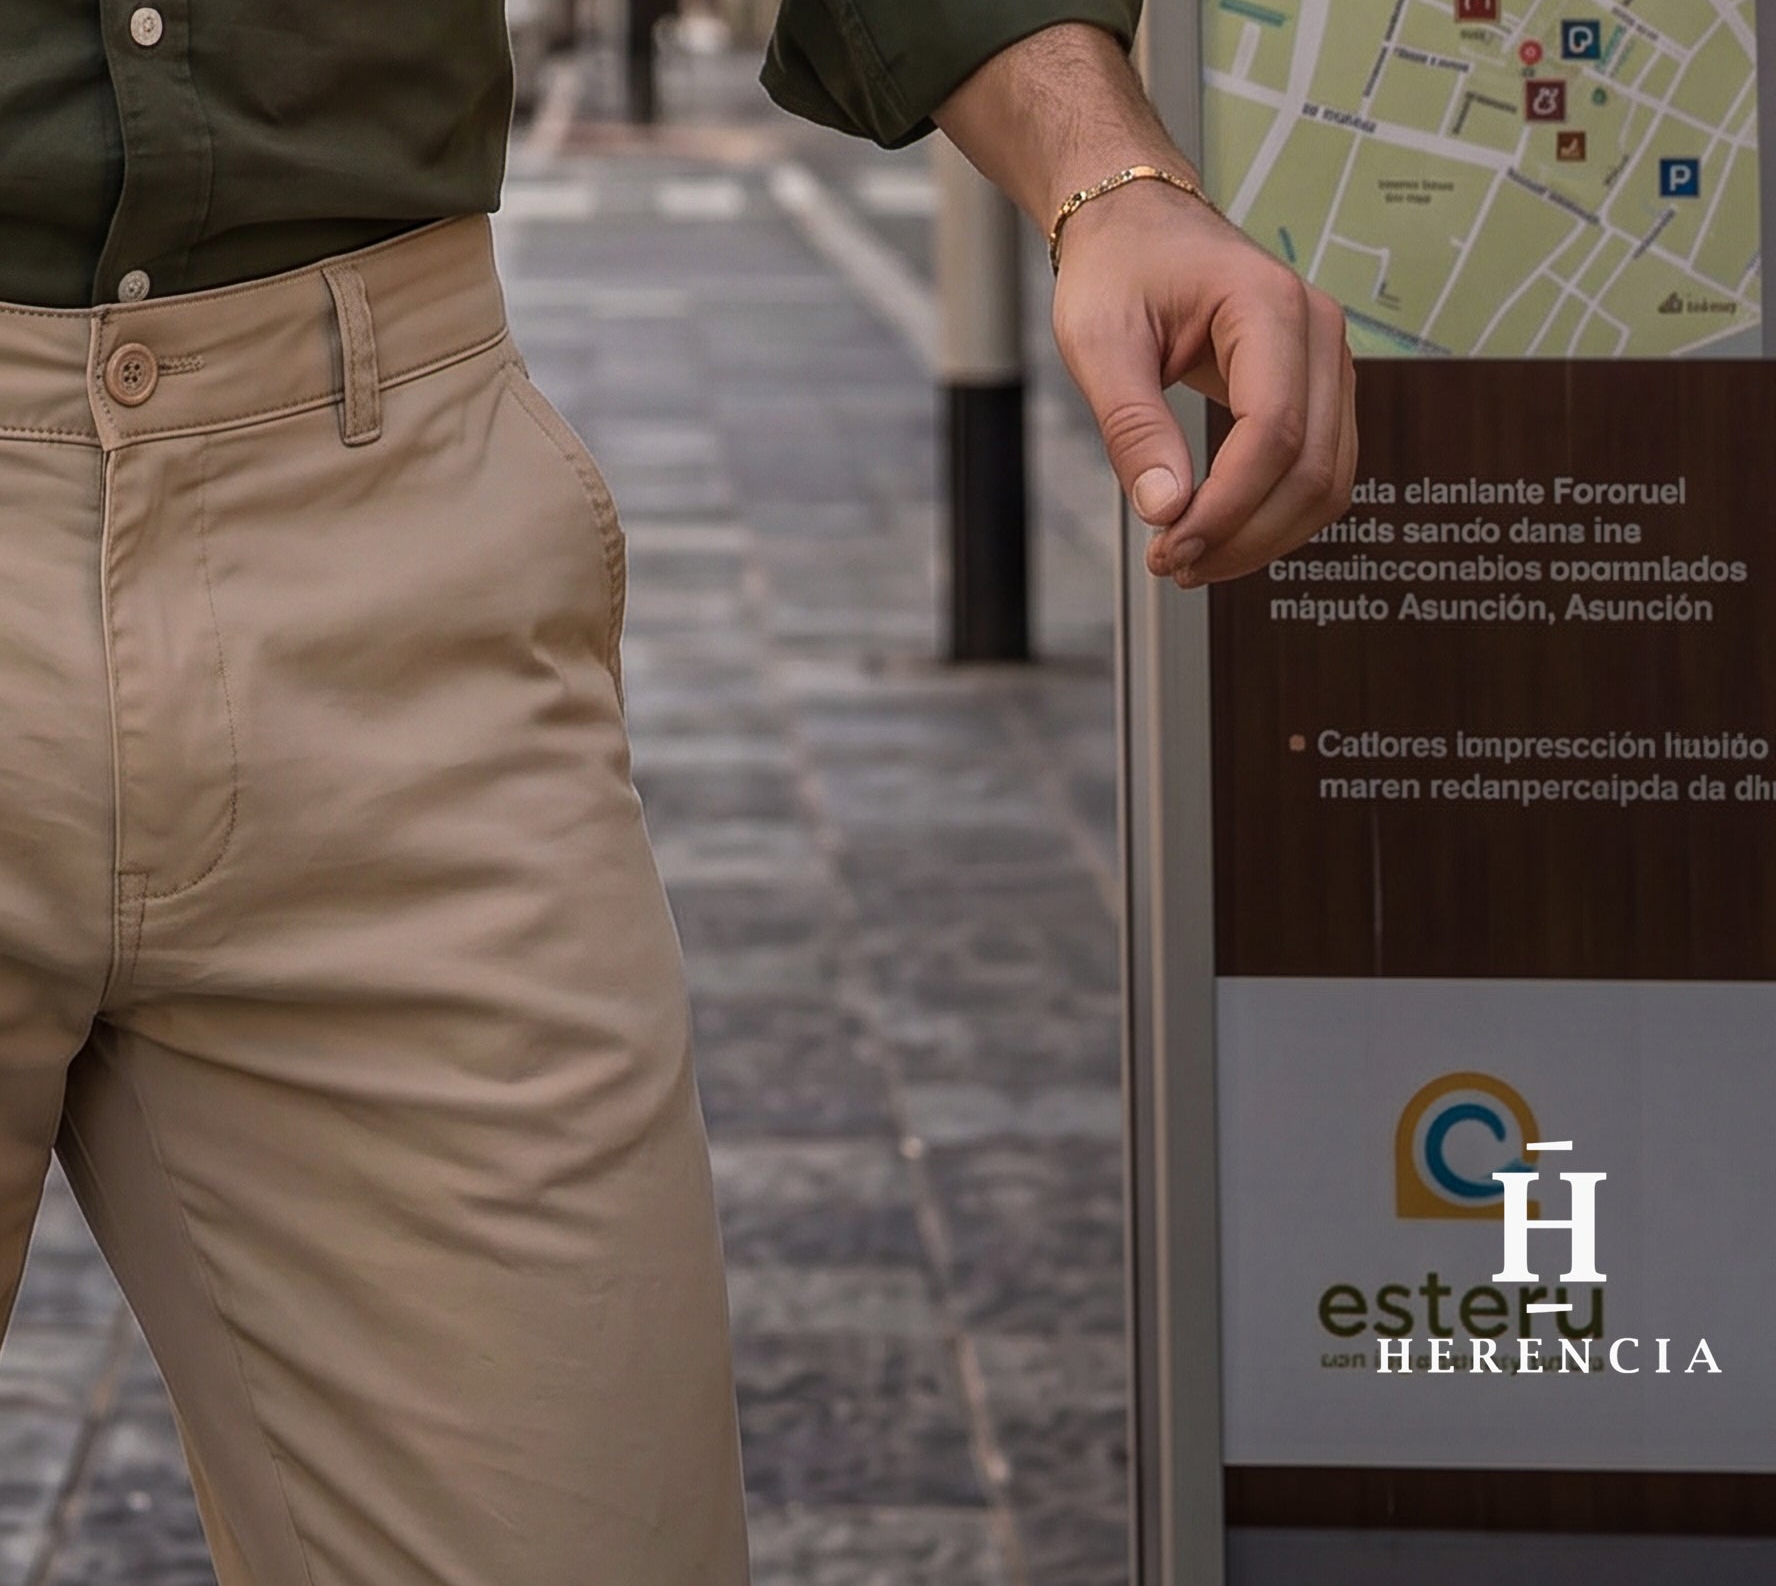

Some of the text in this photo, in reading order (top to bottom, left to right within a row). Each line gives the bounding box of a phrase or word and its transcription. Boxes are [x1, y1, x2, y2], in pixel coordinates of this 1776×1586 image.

[1554, 476, 1686, 505] Fororuel
[1594, 516, 1642, 544] ine
[1398, 592, 1556, 626] Asunción,
[1564, 592, 1713, 622] Asunción
[1320, 778, 1420, 799] maren
[1688, 774, 1726, 801] da
